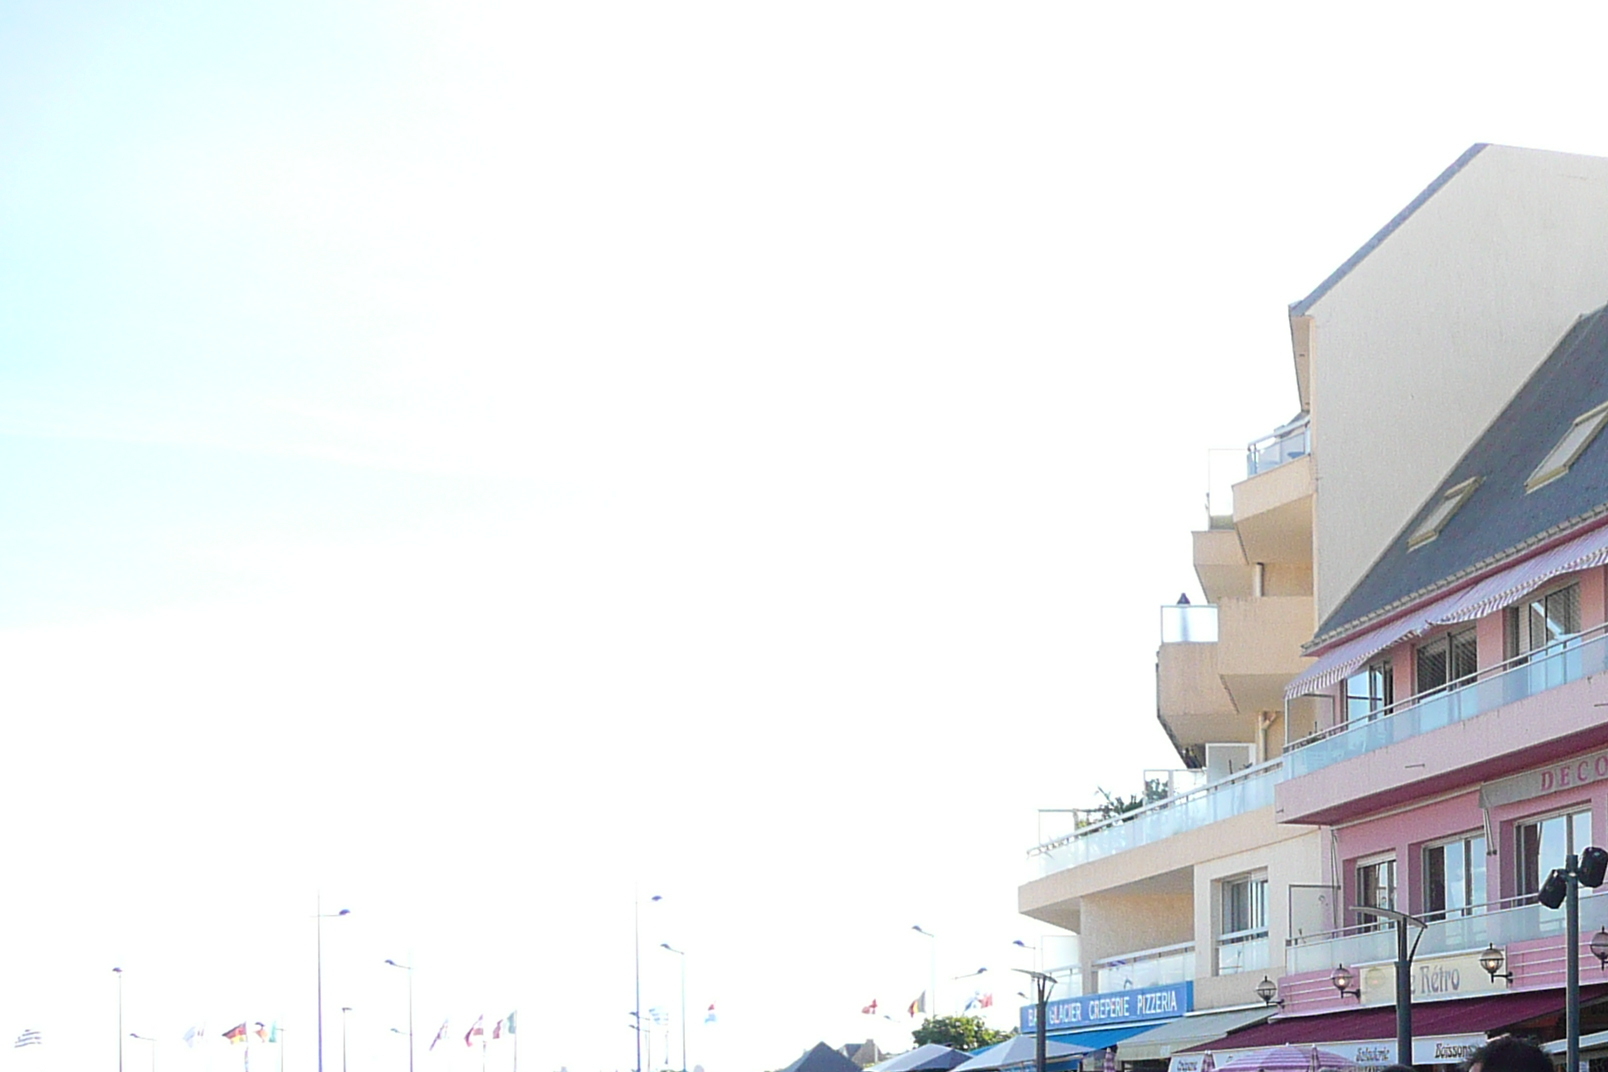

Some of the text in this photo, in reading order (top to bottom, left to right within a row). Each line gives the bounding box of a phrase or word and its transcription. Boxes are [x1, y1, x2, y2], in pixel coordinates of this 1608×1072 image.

[1541, 756, 1608, 792] DECO
[1419, 964, 1460, 994] Rétro
[1050, 1002, 1082, 1025] GLACIER
[1136, 989, 1178, 1016] PIZZERIA
